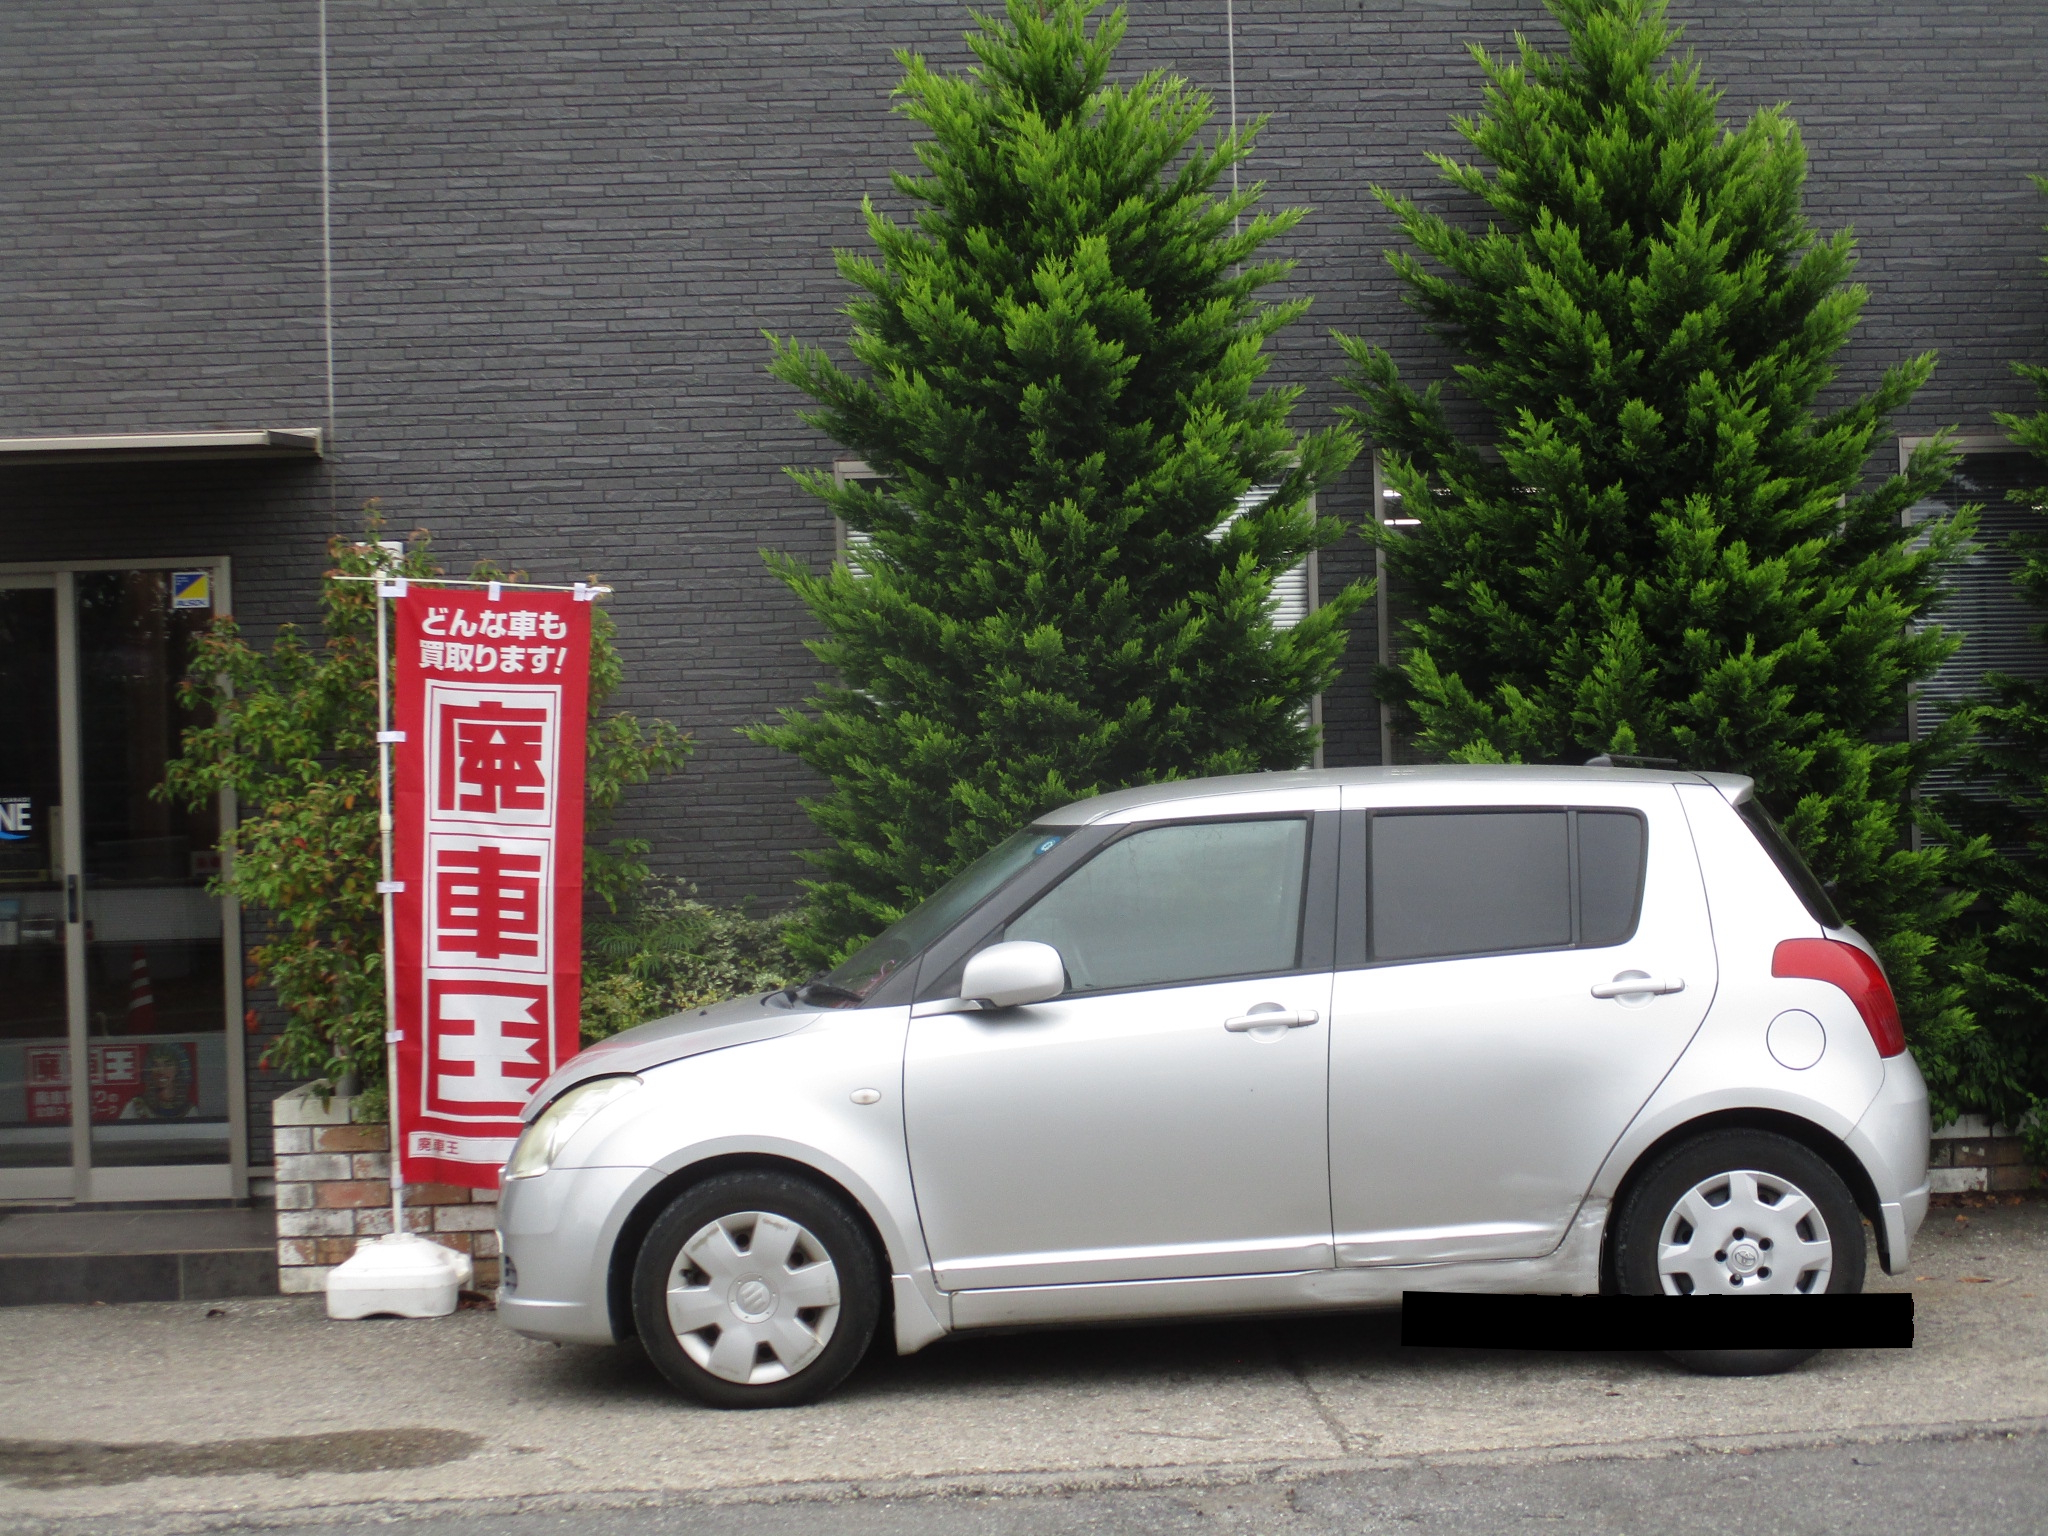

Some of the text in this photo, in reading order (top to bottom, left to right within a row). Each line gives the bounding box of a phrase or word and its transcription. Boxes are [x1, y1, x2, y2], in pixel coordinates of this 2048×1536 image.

[421, 606, 568, 640] どんな車も
[418, 639, 568, 675] 買取ります!
[437, 699, 547, 1101] 廃車王
[417, 1137, 460, 1155] 廃車王
